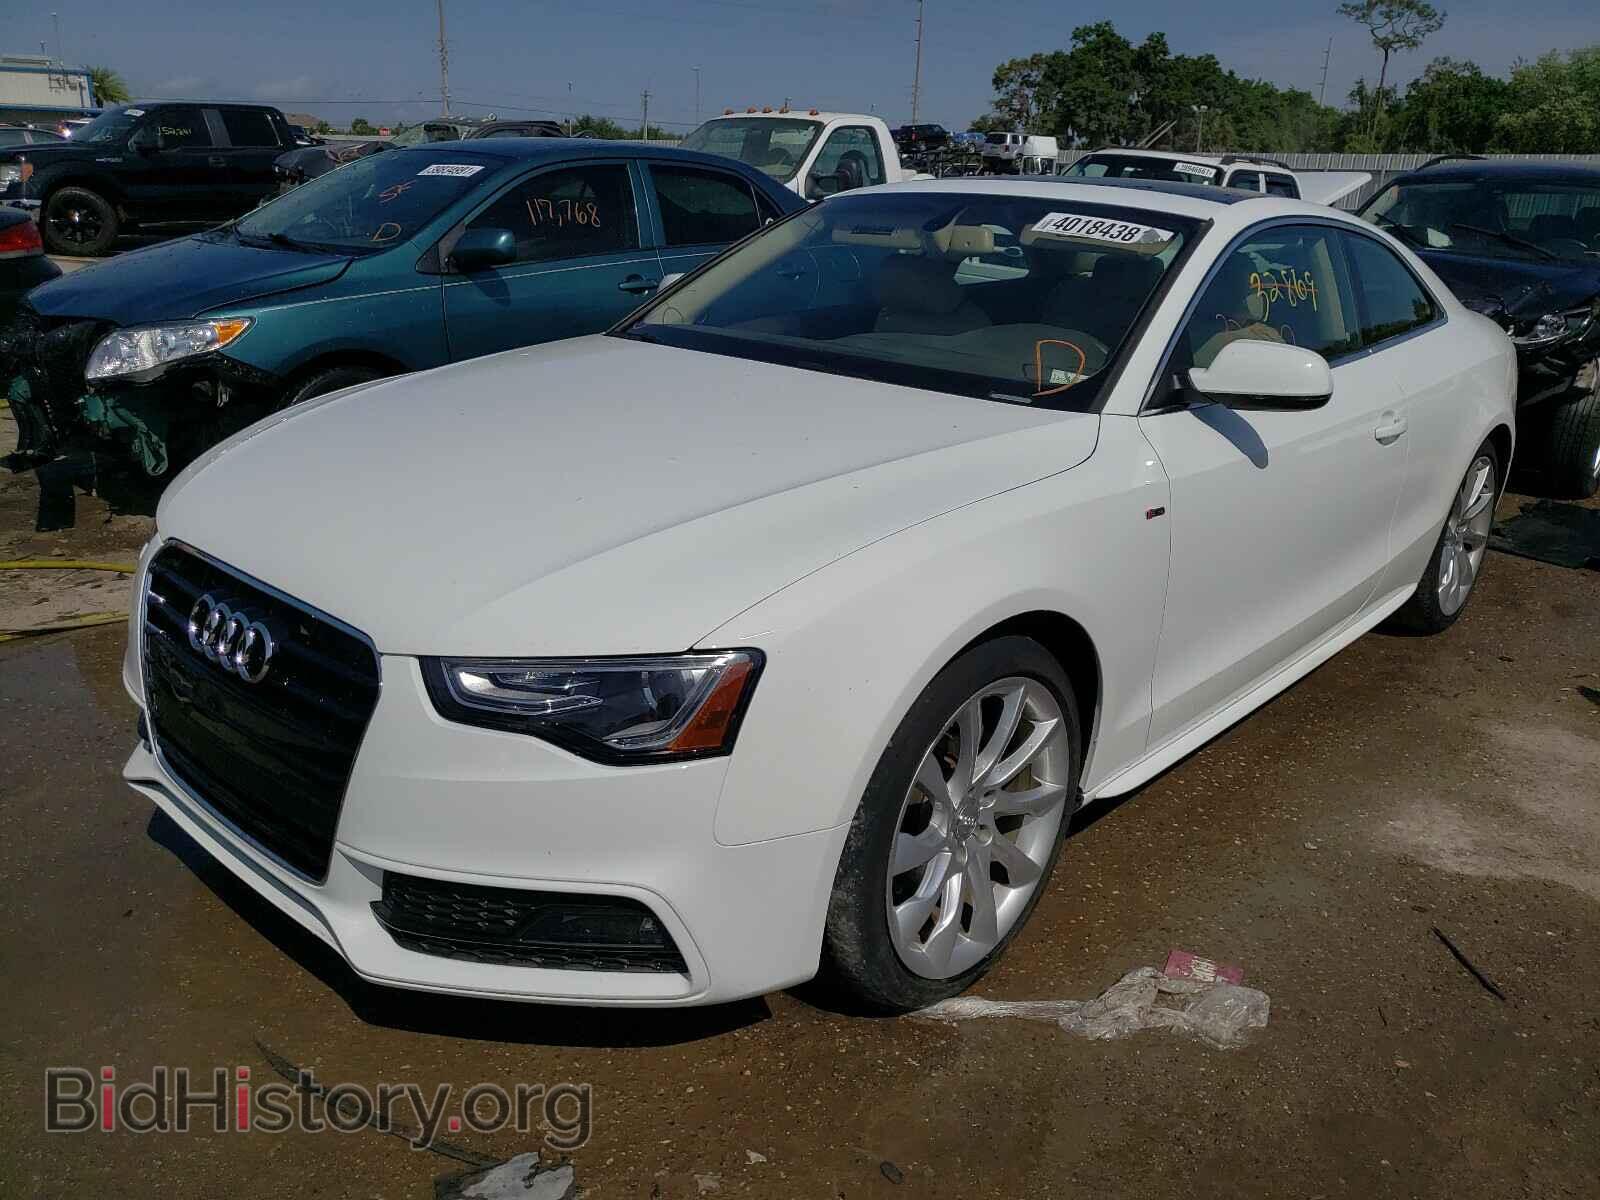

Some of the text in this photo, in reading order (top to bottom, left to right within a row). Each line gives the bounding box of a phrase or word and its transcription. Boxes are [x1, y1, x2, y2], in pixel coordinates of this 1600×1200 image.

[525, 198, 601, 228] 117,768
[373, 222, 402, 241] D
[1053, 216, 1141, 242] 4018438
[1032, 339, 1086, 397] D
